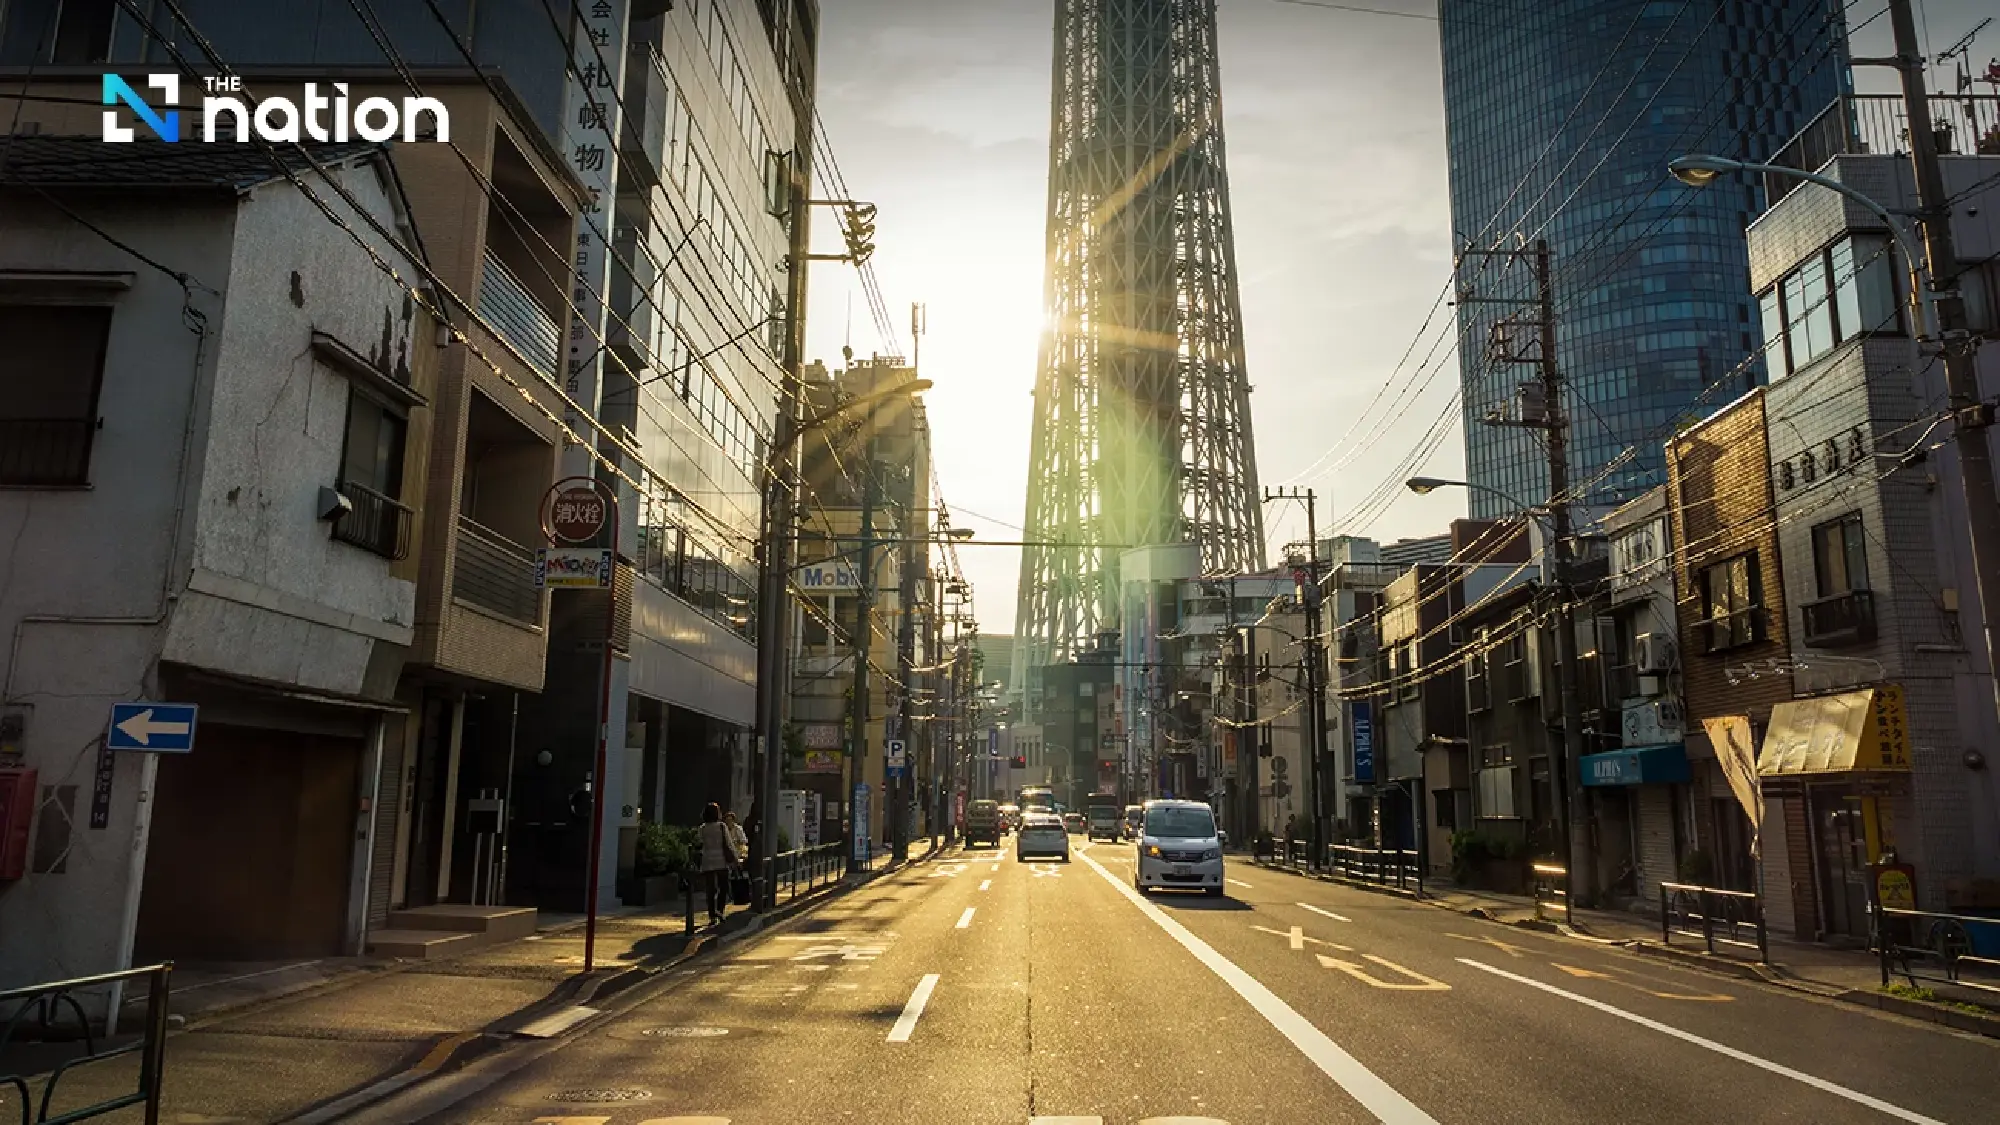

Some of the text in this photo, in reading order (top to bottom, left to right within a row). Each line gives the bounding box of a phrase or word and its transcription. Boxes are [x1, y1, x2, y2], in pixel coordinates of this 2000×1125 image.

[554, 502, 601, 524] 消火栓
[891, 742, 903, 757] P
